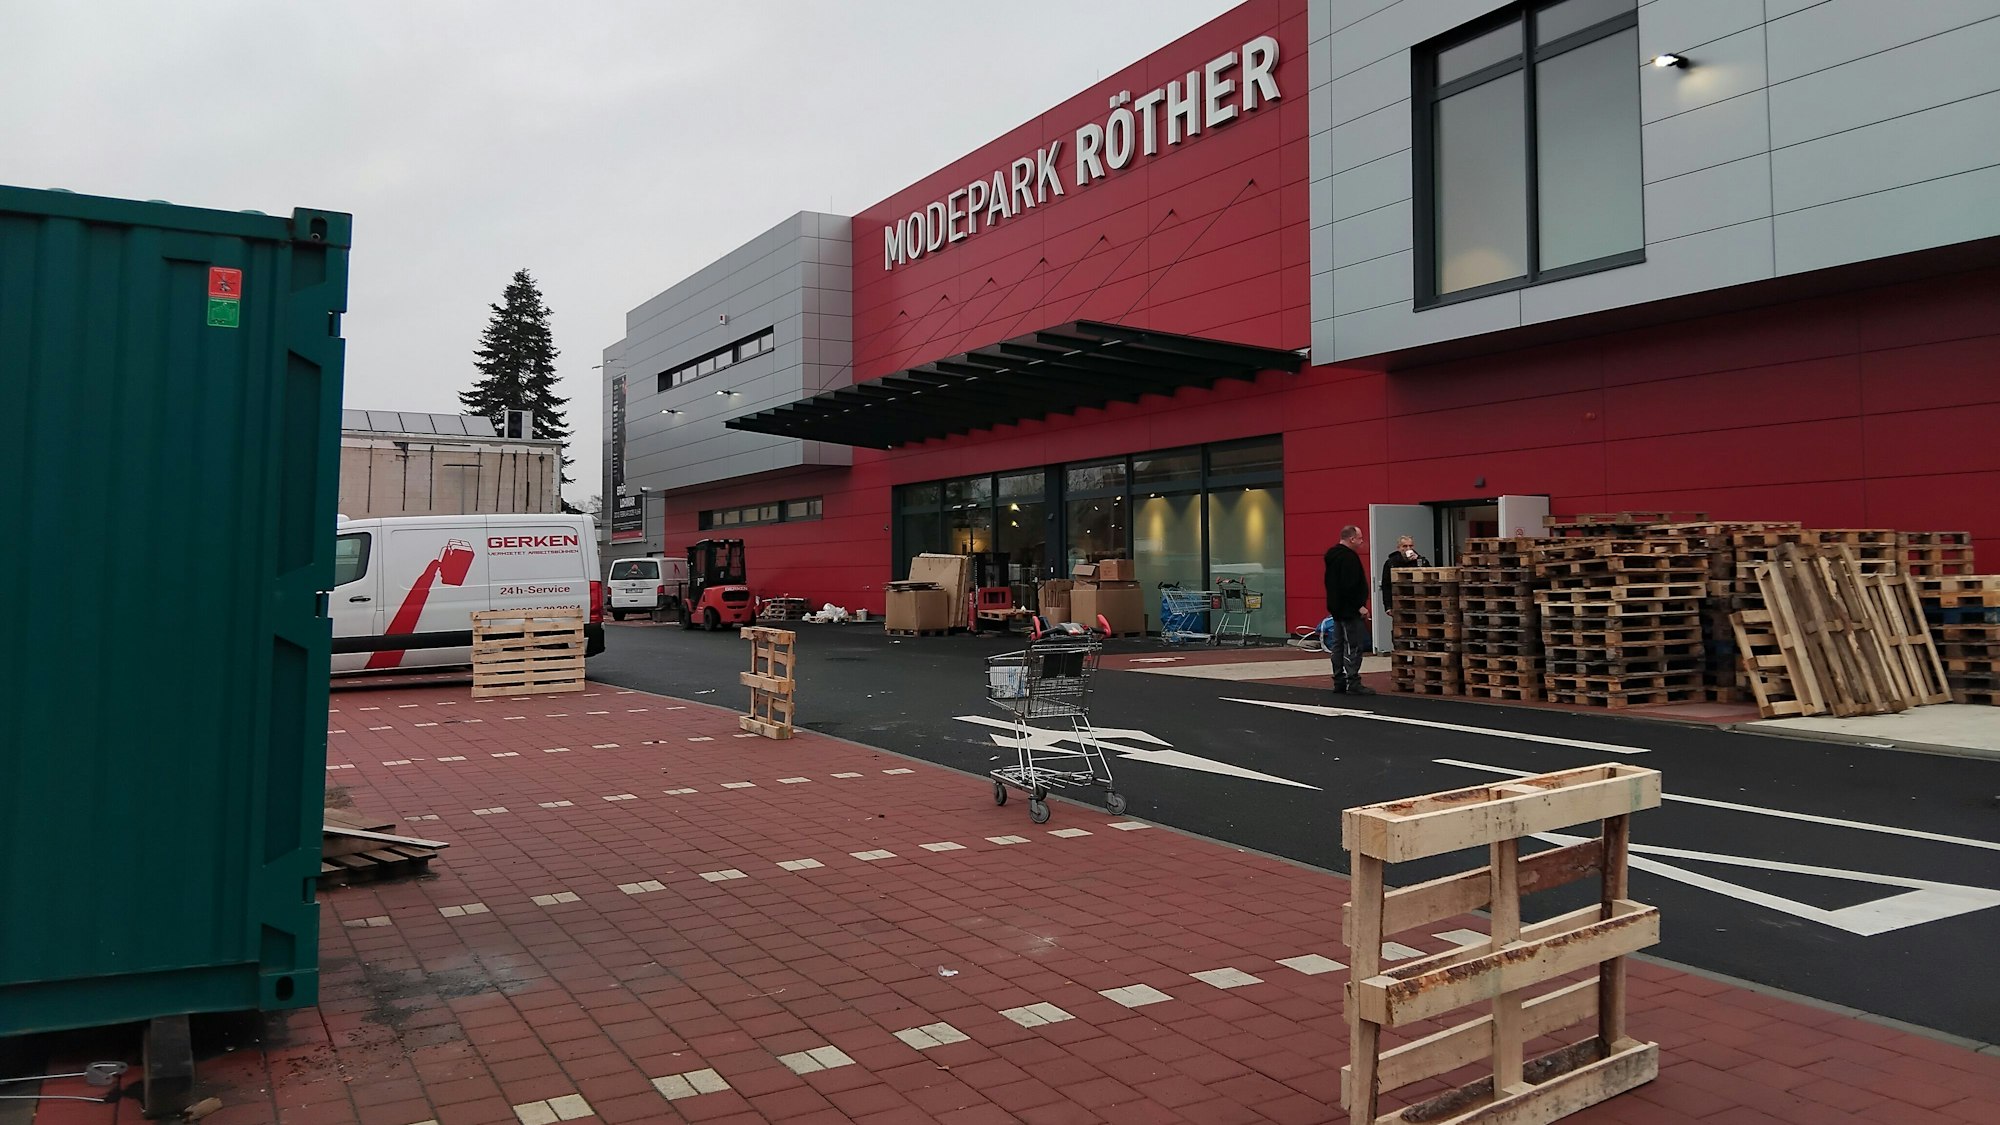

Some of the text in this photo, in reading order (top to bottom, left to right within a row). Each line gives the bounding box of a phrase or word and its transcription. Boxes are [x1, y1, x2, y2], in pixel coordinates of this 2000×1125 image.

[884, 35, 1281, 271] MODEPARK RÖTHER
[487, 534, 578, 549] GERKEN
